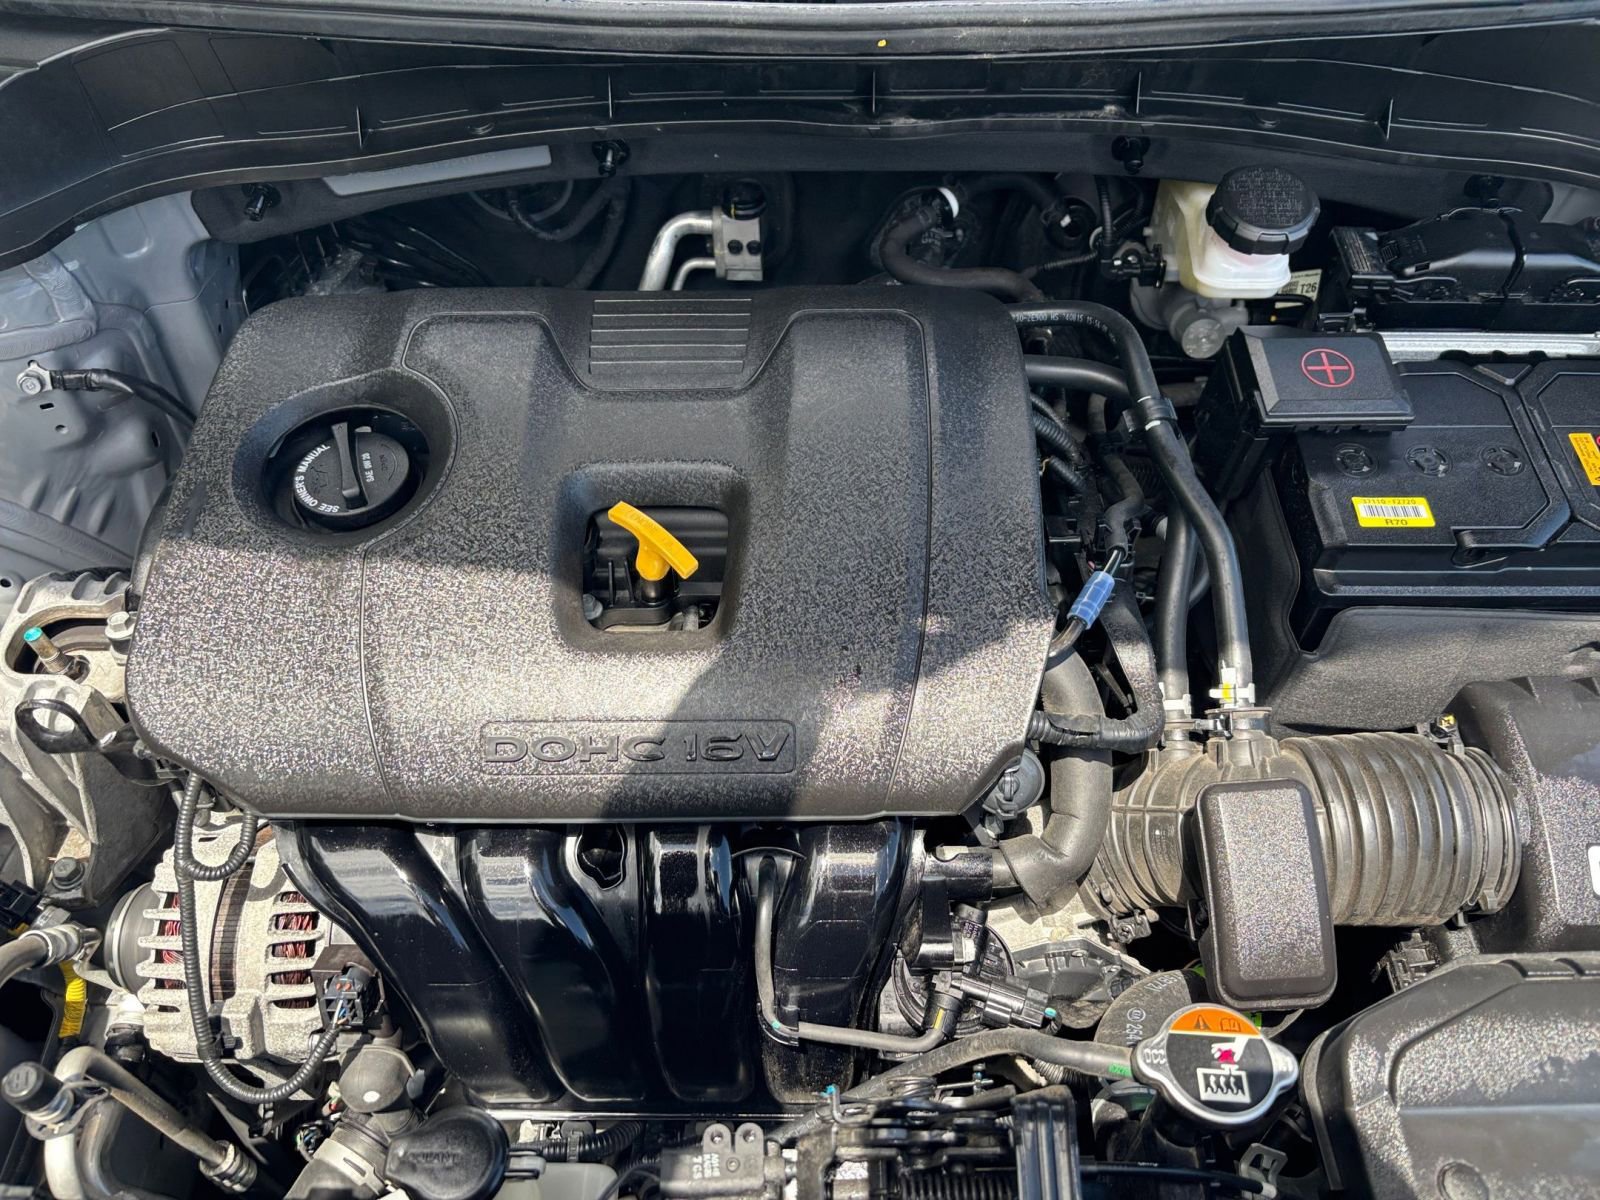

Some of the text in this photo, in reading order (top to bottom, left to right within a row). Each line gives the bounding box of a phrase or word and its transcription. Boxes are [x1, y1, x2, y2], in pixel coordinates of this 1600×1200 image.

[1301, 282, 1317, 294] T26
[295, 444, 340, 513] SEE OWNER'S MANUAL
[365, 469, 375, 482] SAE
[484, 733, 790, 763] DOHC 16V
